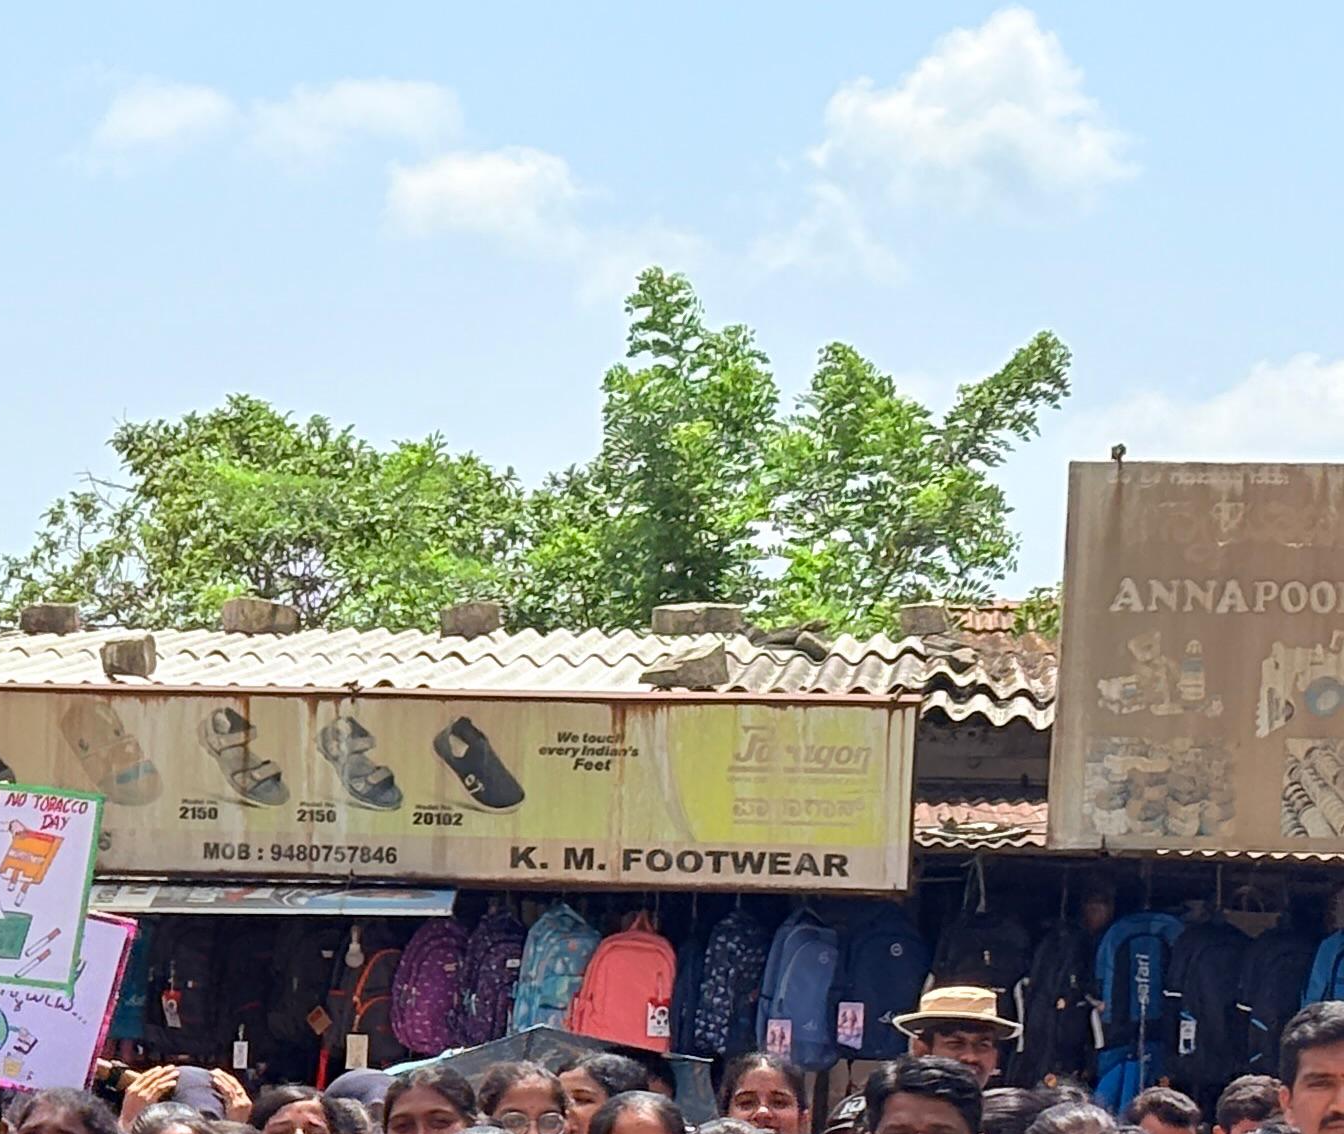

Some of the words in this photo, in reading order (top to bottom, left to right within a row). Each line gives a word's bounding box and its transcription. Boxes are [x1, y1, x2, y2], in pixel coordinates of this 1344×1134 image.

[1109, 577, 1344, 614] ANNAPOO
[557, 731, 579, 743] We
[582, 732, 624, 743] touch
[538, 746, 580, 758] every
[581, 745, 639, 757] Indian's
[573, 758, 611, 771] Feet
[5, 792, 28, 807] NO
[32, 794, 89, 814] TOBACCO
[179, 806, 218, 820] 2150
[296, 808, 336, 823] 2150
[412, 812, 463, 826] 20102
[40, 814, 71, 831] DAY
[203, 842, 250, 860] MOB
[270, 843, 397, 864] 9480757846
[510, 846, 548, 870] K.
[563, 846, 606, 871] M.
[622, 847, 850, 878] FOOTWEAR
